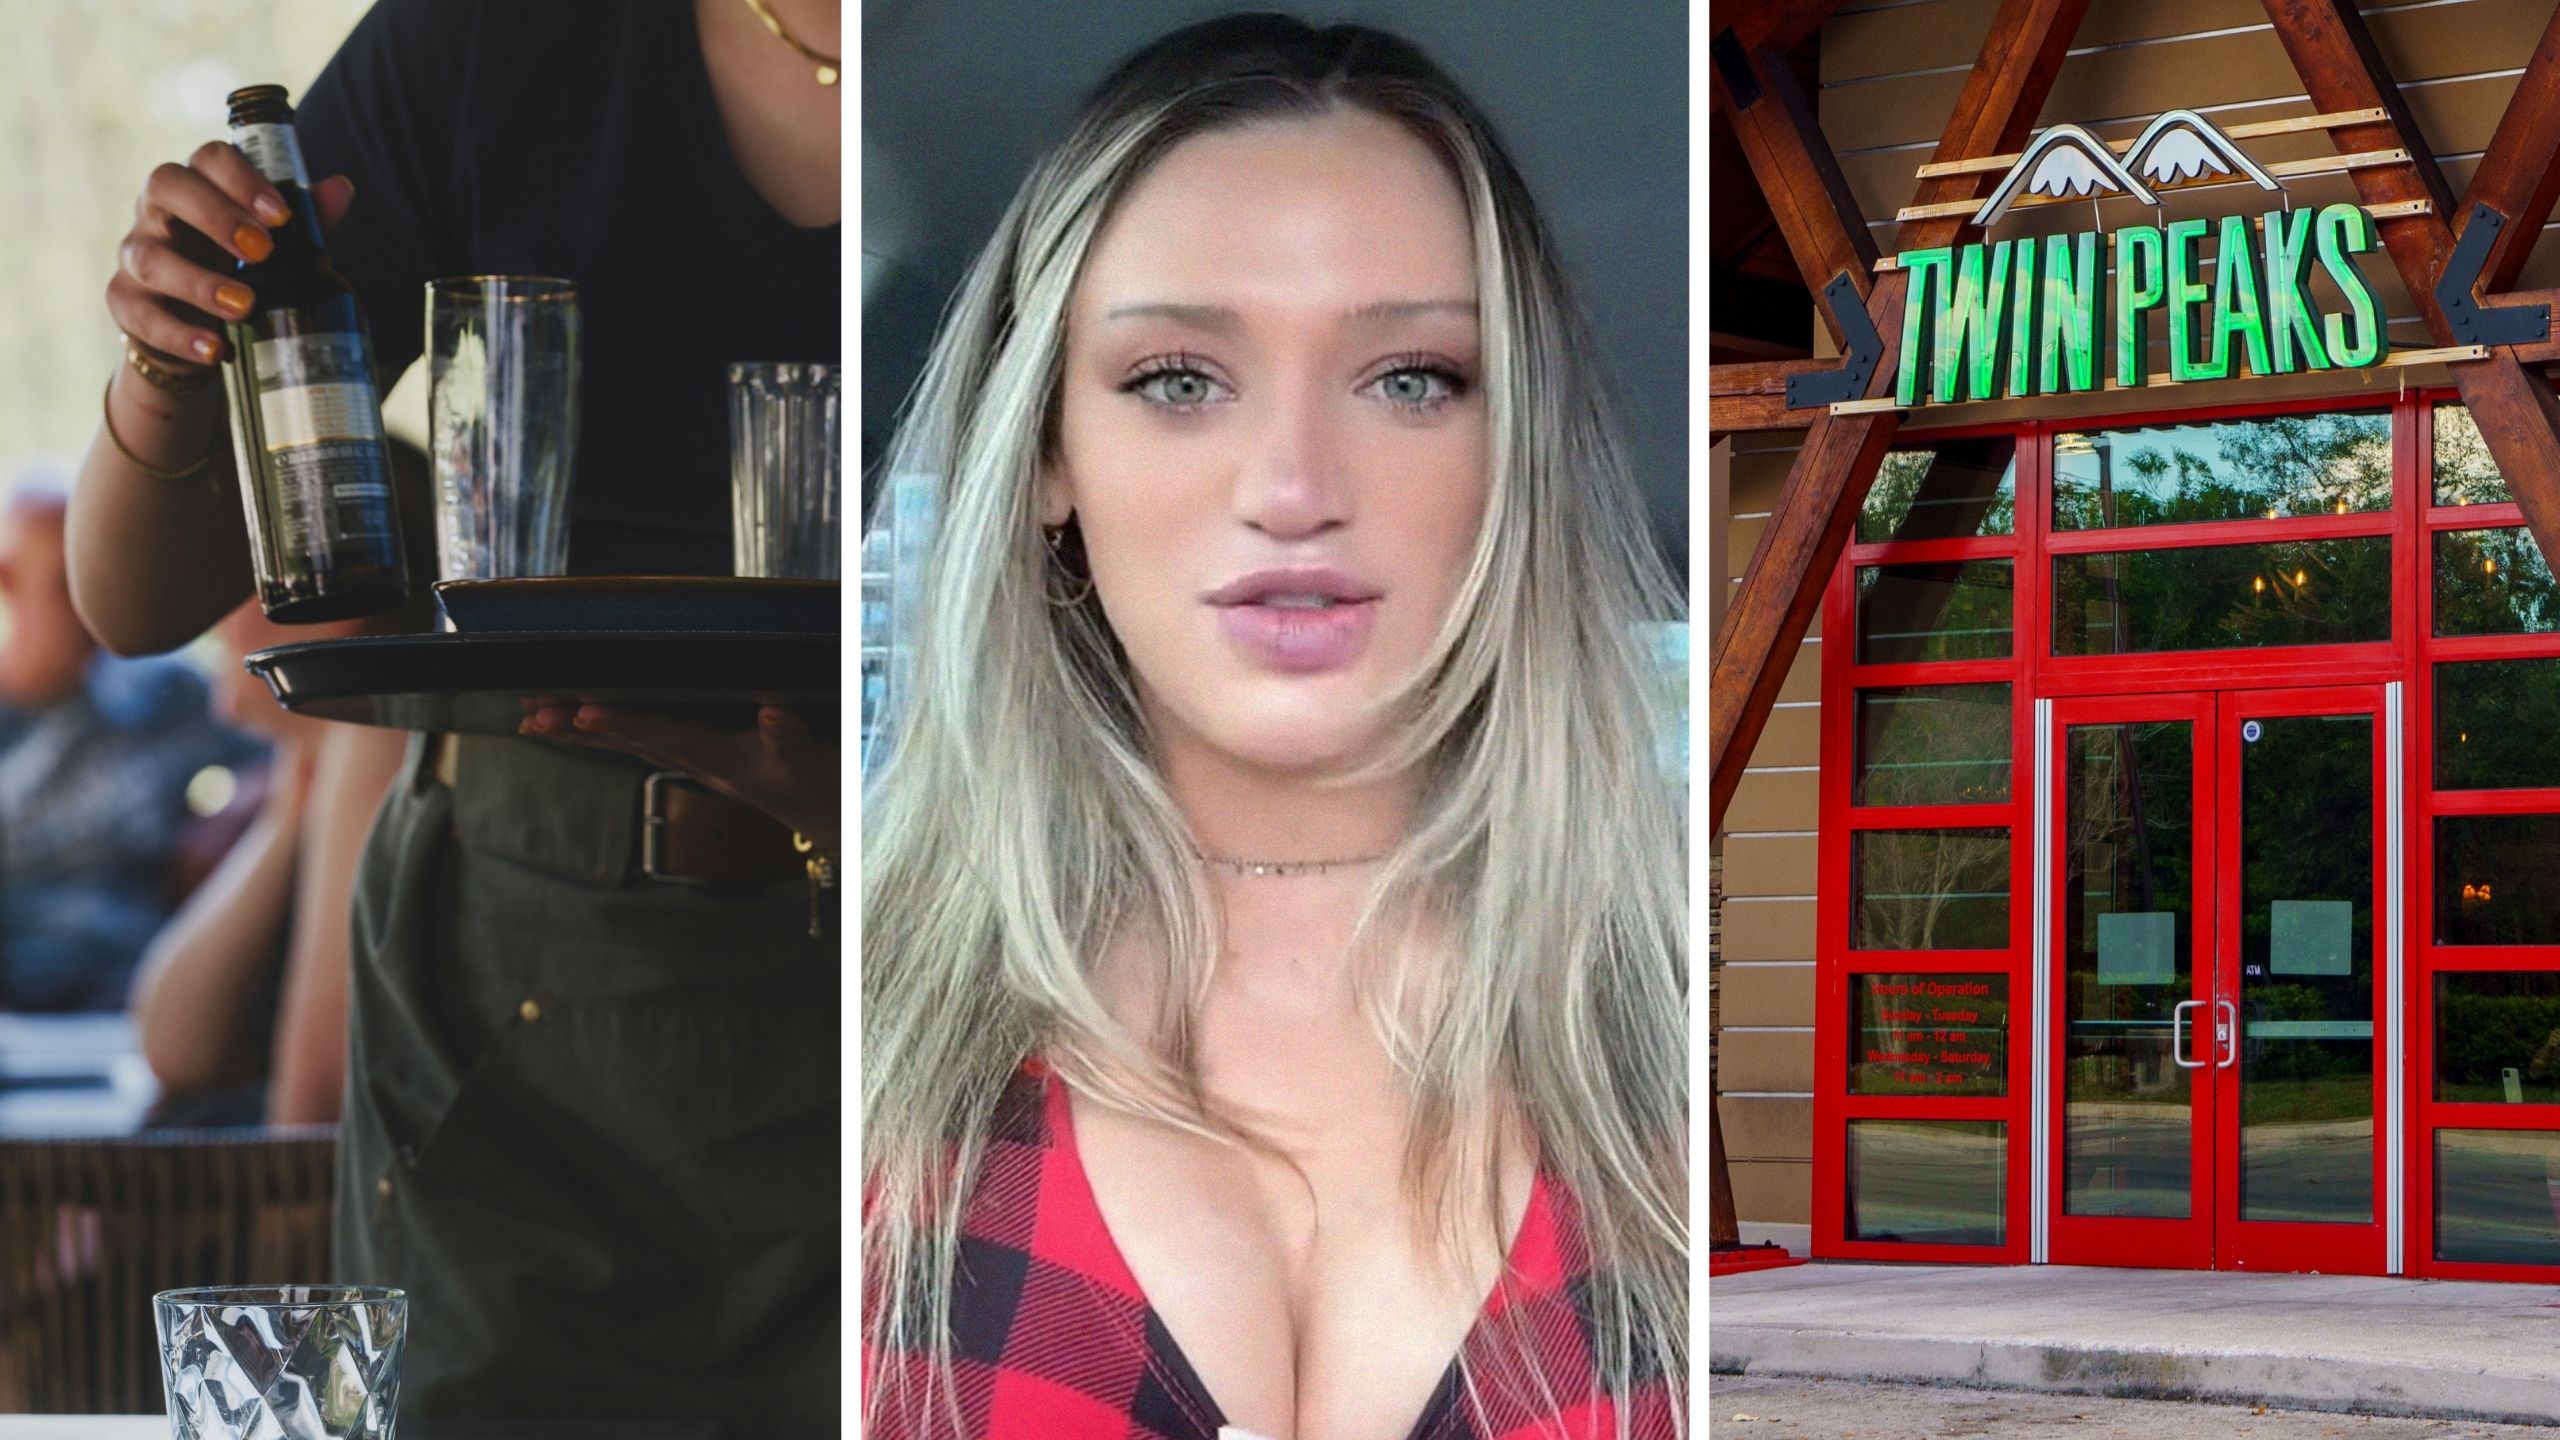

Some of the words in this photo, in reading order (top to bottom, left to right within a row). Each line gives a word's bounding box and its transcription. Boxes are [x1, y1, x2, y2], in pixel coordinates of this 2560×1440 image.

[1894, 231, 2108, 407] TWIN
[2115, 202, 2389, 388] PEAKS
[2246, 965, 2261, 976] ATM
[1871, 983, 1908, 996] Hours
[1912, 982, 1925, 996] of
[1928, 982, 1990, 998] Operation
[1881, 1008, 1921, 1023] Sunday
[1932, 1008, 1978, 1023] Tuesday
[1934, 1029, 1947, 1041] 12
[1949, 1032, 1967, 1042] am
[1940, 1050, 1990, 1068] Saturday
